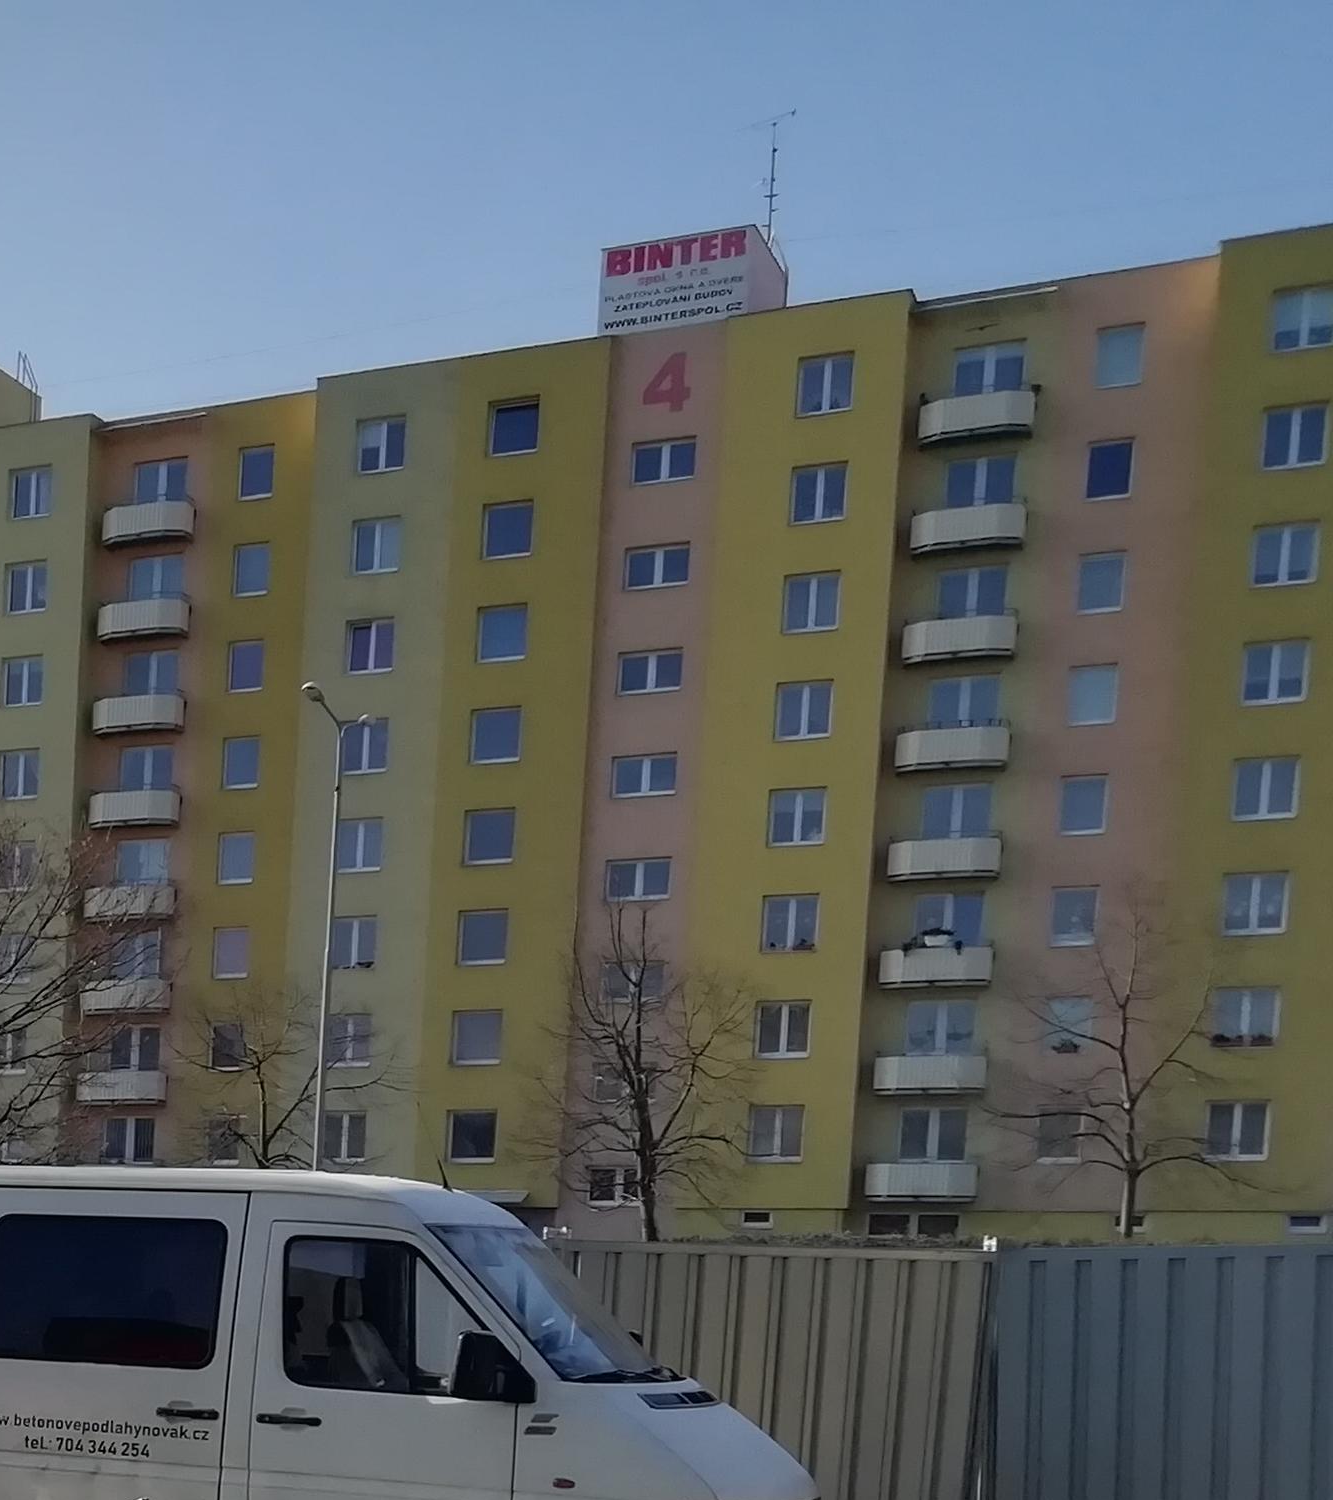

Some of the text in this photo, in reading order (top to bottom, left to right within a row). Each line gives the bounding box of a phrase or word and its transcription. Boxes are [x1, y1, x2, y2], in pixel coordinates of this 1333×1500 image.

[606, 230, 747, 277] BINTER
[604, 301, 744, 330] WWW.BINTERSPOL.CZ
[642, 352, 691, 412] 4
[56, 1437, 84, 1453] 704
[88, 1440, 117, 1456] 344
[121, 1442, 150, 1459] 254
